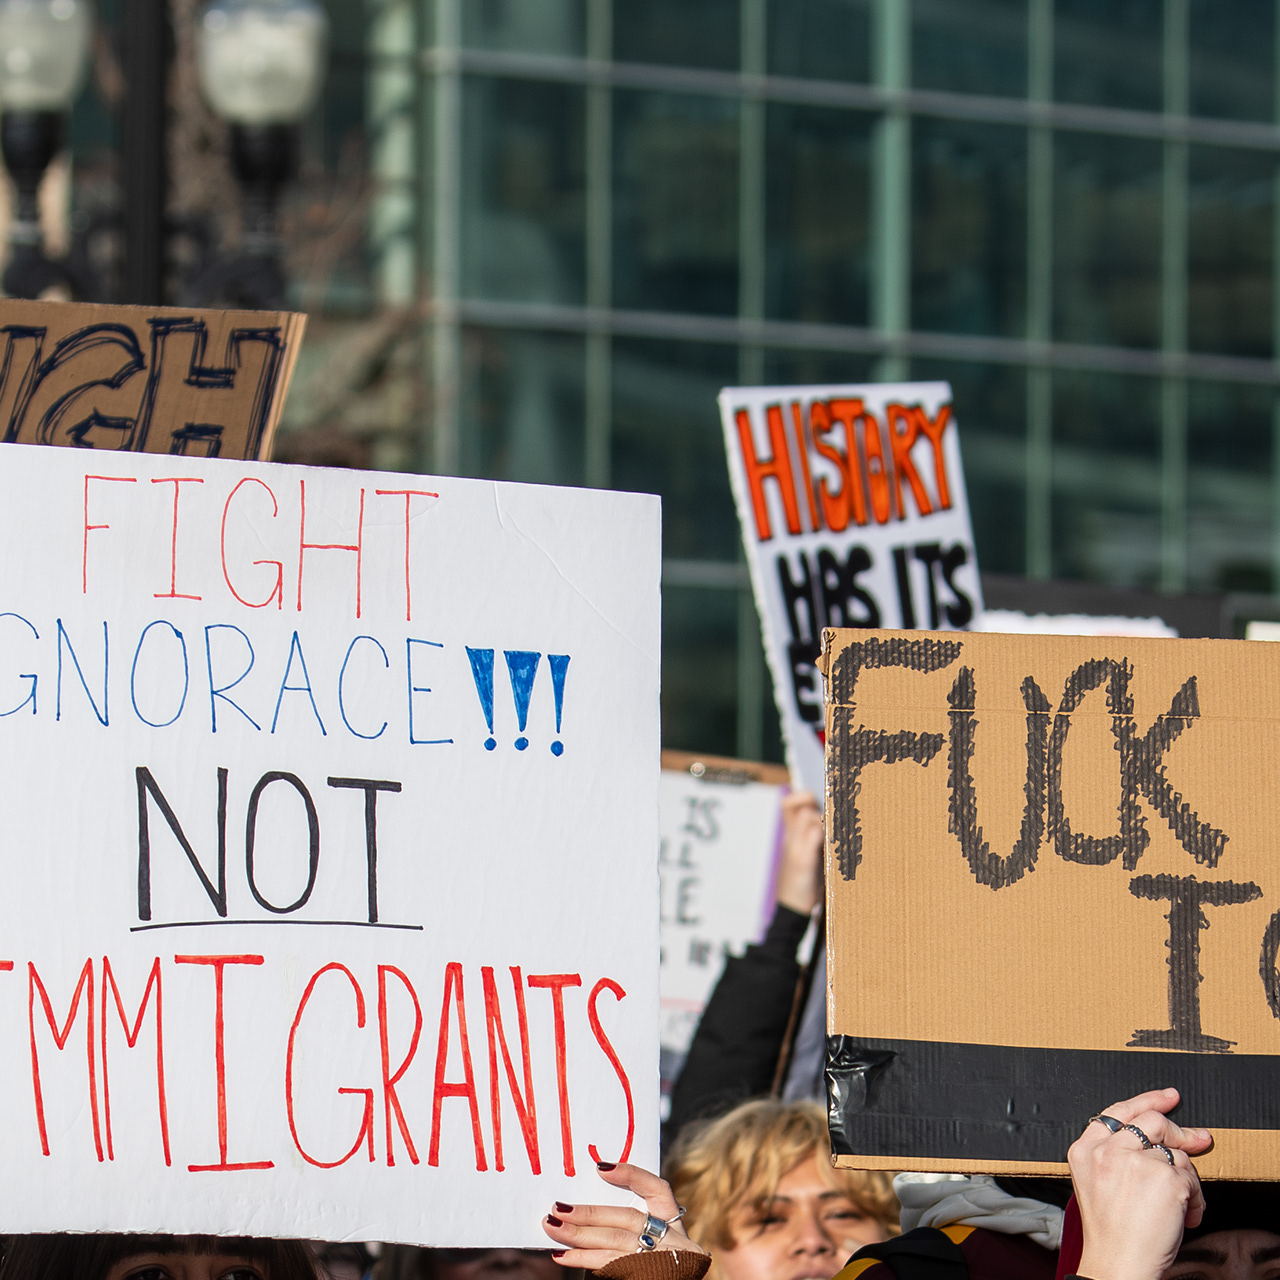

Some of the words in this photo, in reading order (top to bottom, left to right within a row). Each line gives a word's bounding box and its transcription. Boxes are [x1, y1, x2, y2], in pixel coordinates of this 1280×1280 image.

[735, 398, 954, 541] HISTORY
[83, 474, 440, 622] FIGHT
[776, 544, 881, 646] HAS
[892, 540, 974, 630] ITS
[828, 636, 1229, 891] FUCK
[136, 766, 402, 924] NOT
